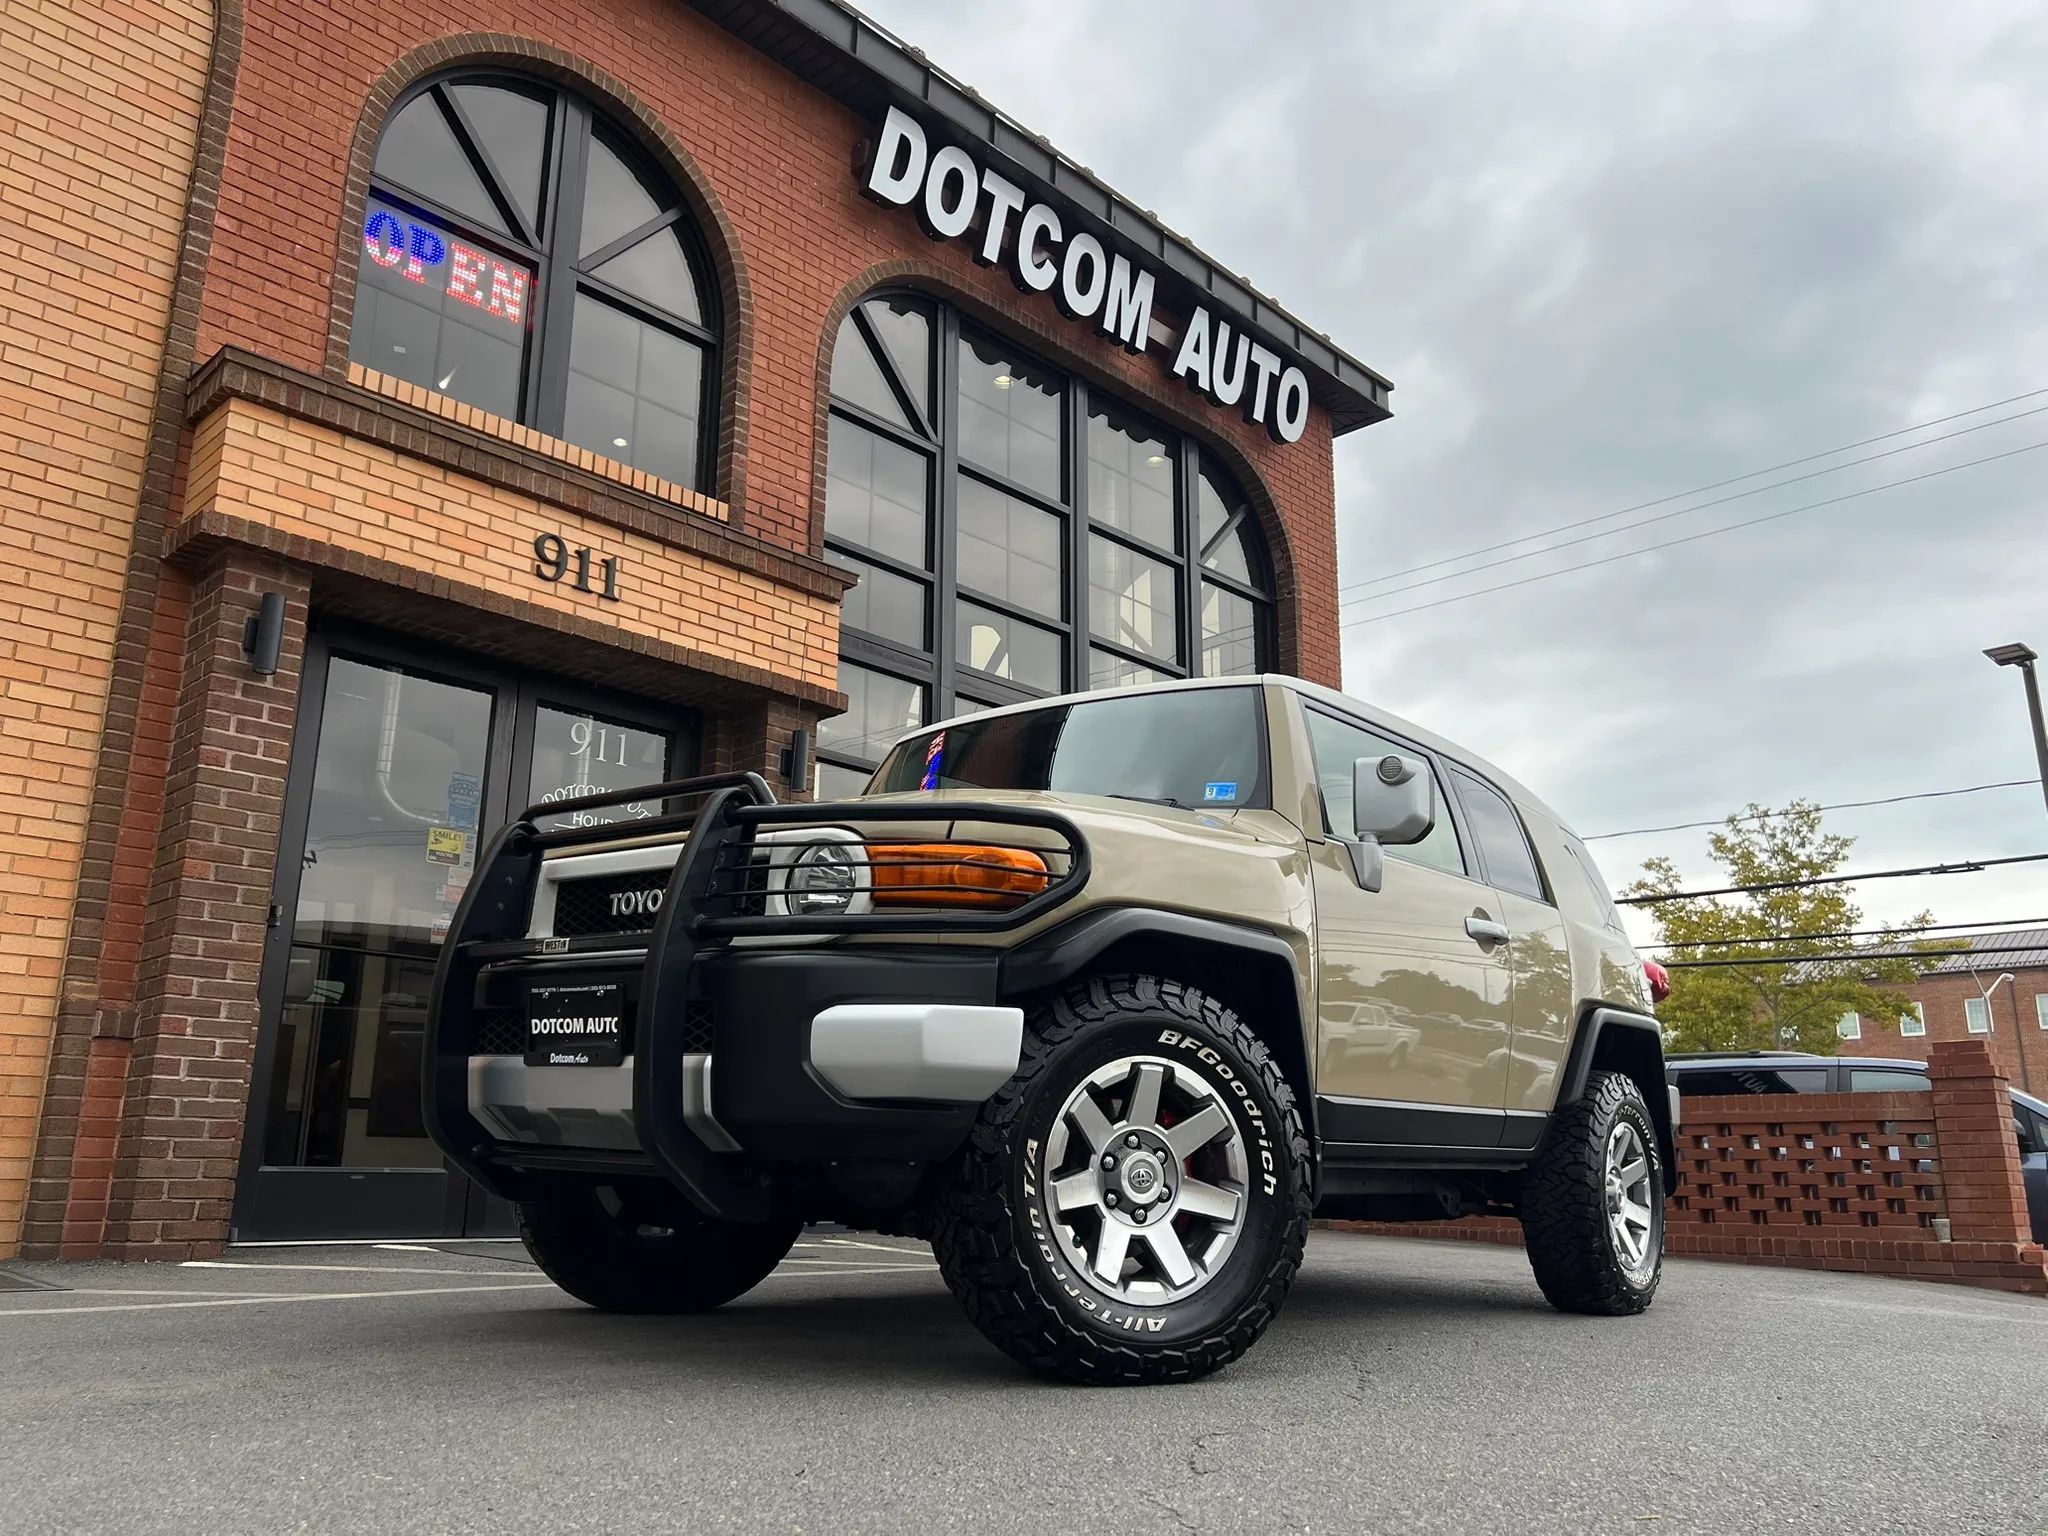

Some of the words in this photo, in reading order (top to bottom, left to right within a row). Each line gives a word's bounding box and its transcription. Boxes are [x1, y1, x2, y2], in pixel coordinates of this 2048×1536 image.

[365, 209, 527, 323] OPEN
[868, 104, 1156, 352] DOTCOM
[1173, 305, 1310, 443] AUTO
[534, 533, 619, 603] 911
[569, 722, 628, 767] 911
[609, 888, 667, 916] TOYO
[531, 1017, 584, 1035] DOTCOM
[1157, 1029, 1278, 1197] BFGoodrich
[1023, 1138, 1039, 1199] T/A
[1029, 1206, 1168, 1333] All-Terrain
